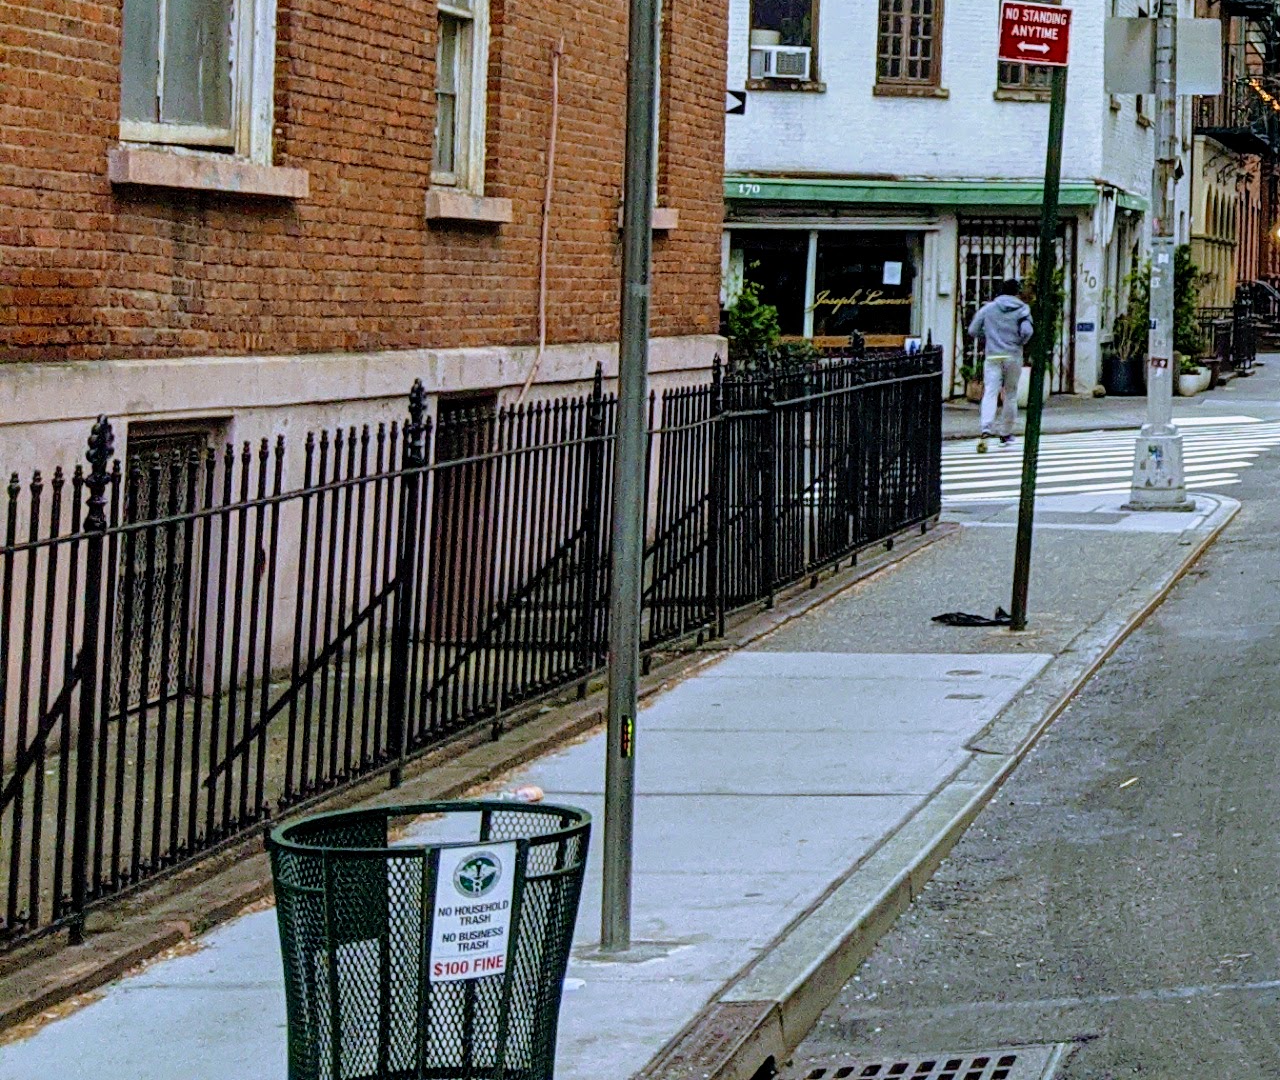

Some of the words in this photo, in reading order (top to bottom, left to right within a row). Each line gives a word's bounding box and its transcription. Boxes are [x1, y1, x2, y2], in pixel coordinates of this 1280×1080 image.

[1005, 8, 1020, 20] NO
[1022, 9, 1067, 25] STANDING
[1011, 24, 1059, 40] ANYTIME
[738, 183, 761, 196] 170
[1079, 262, 1096, 289] 170
[804, 288, 863, 315] Joseph
[438, 907, 452, 917] NO
[454, 900, 509, 916] HOUSEHOLD
[460, 913, 491, 926] TRASH
[442, 932, 456, 943] NO
[458, 926, 504, 941] BUSINESS
[457, 939, 489, 952] TRASH
[433, 961, 469, 977] $100
[473, 954, 505, 972] FINE
